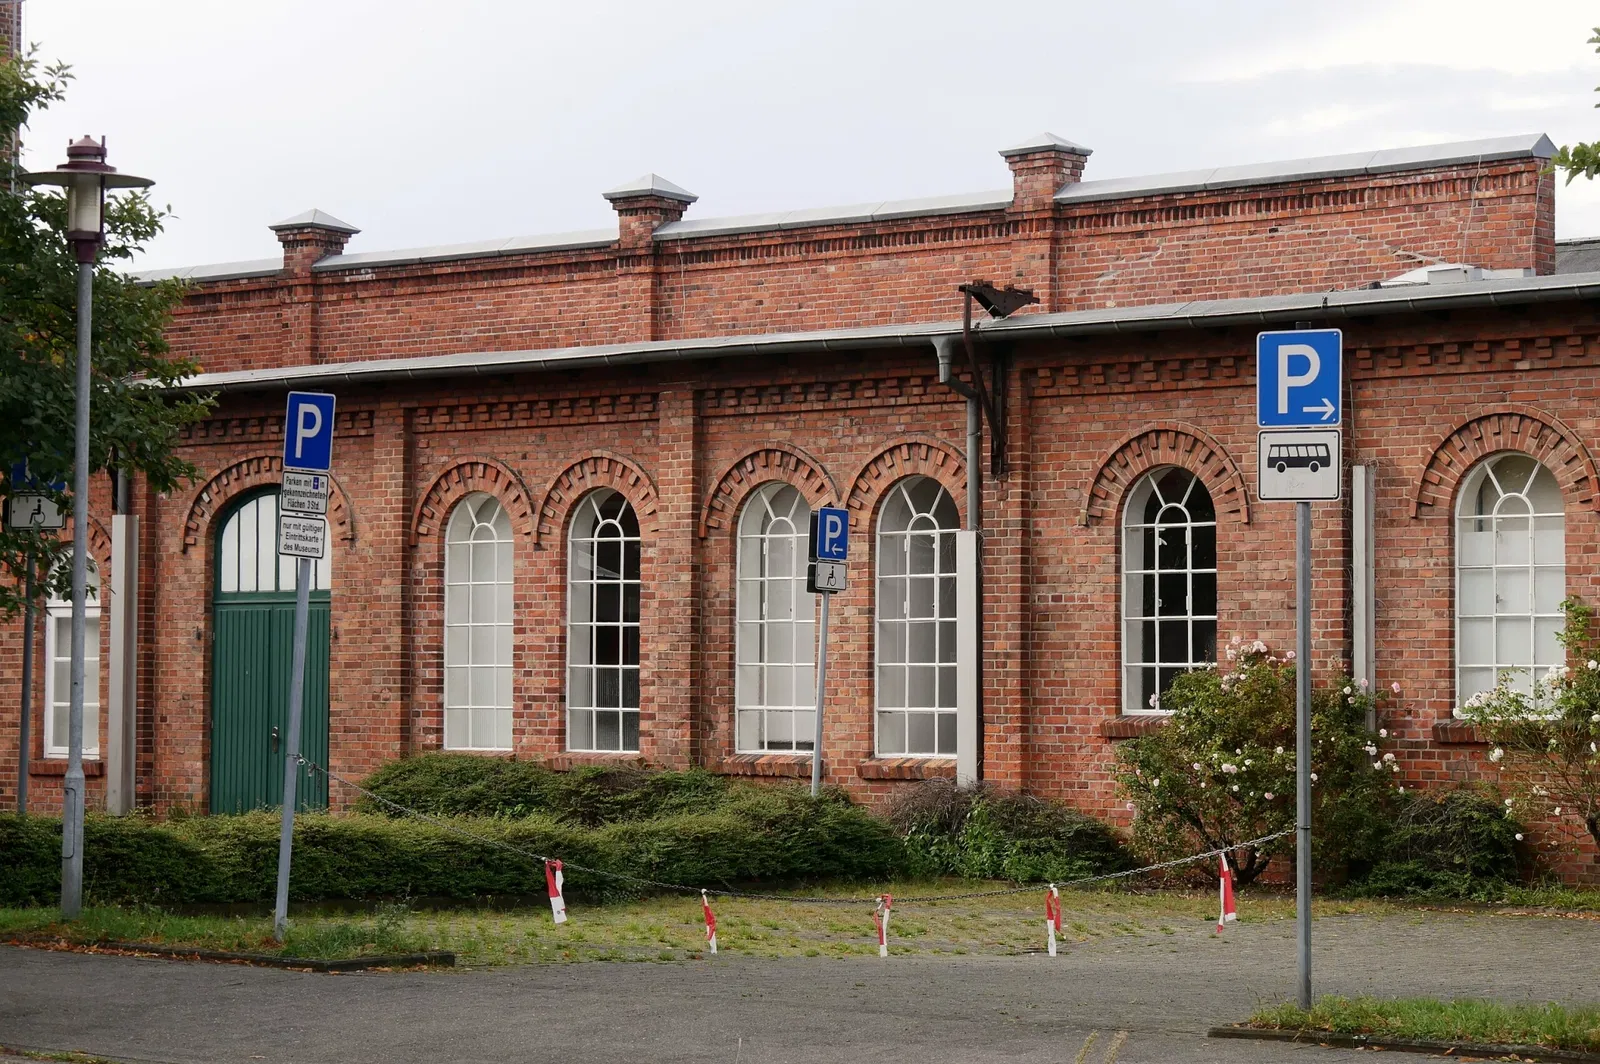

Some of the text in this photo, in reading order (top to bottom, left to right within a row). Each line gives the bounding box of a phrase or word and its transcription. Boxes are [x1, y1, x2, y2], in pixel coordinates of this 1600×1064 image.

[1277, 344, 1321, 414] P
[295, 403, 322, 459] P
[286, 475, 302, 486] Parken
[303, 477, 311, 487] mit
[284, 488, 326, 500] gekennzeichneten
[287, 498, 305, 508] Flächen
[307, 500, 310, 509] 3
[293, 522, 301, 530] mit
[302, 523, 323, 534] gültiger
[825, 514, 842, 553] P
[286, 531, 319, 543] Eintrittskarte
[283, 543, 319, 554] des Museums
